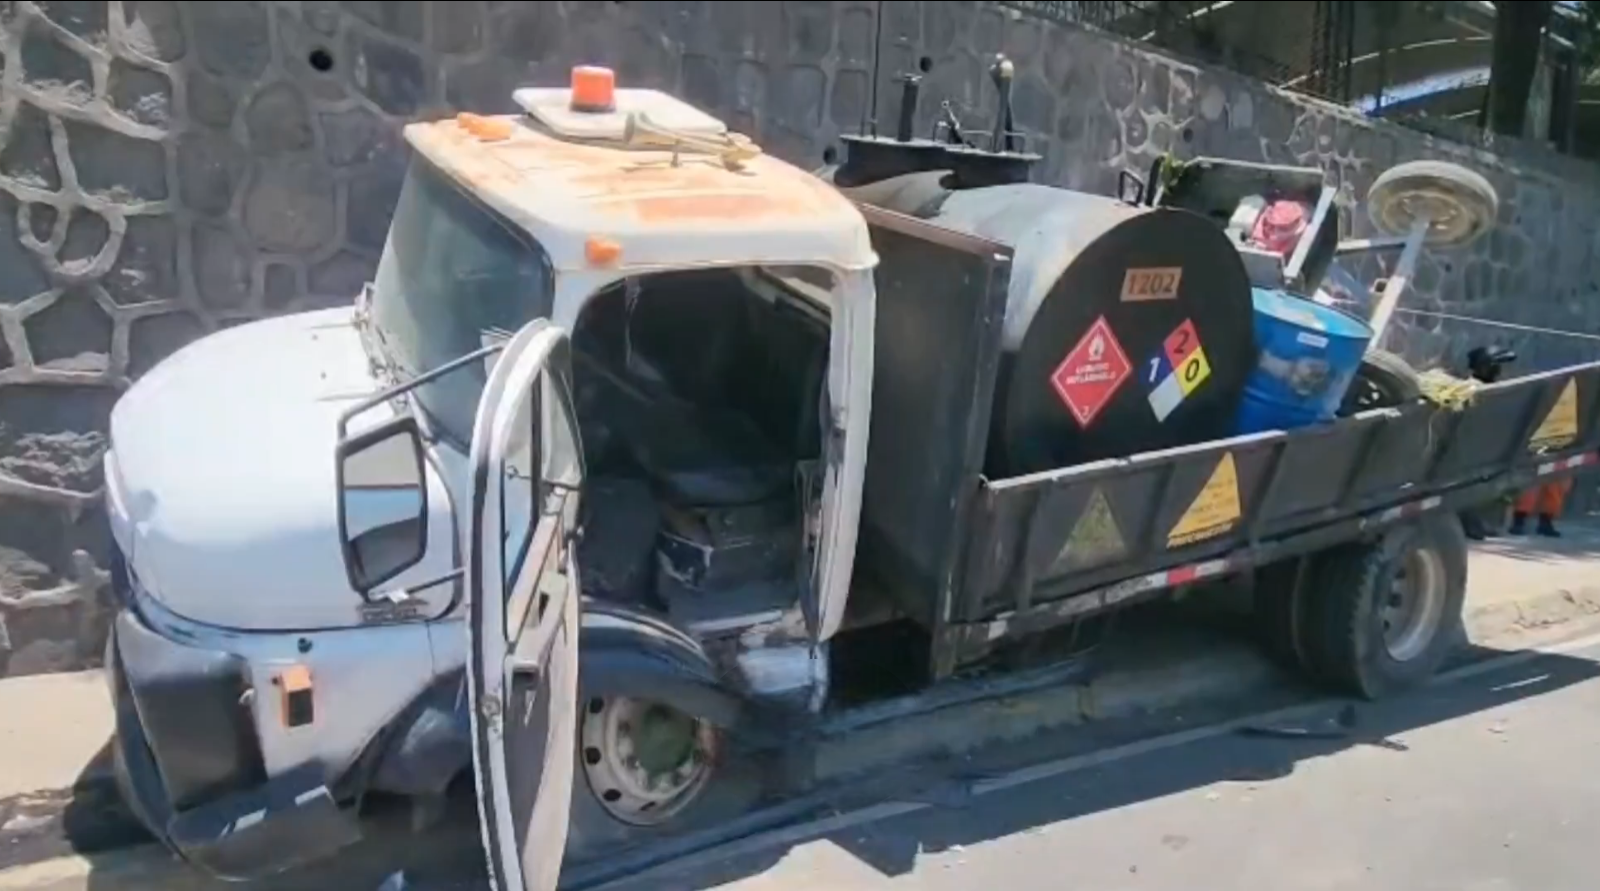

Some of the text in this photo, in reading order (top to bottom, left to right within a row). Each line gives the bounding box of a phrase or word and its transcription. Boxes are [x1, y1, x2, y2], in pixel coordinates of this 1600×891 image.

[1128, 273, 1175, 294] 1202
[1174, 329, 1190, 353] 2
[1149, 357, 1161, 382] 1
[1185, 358, 1200, 383] 0
